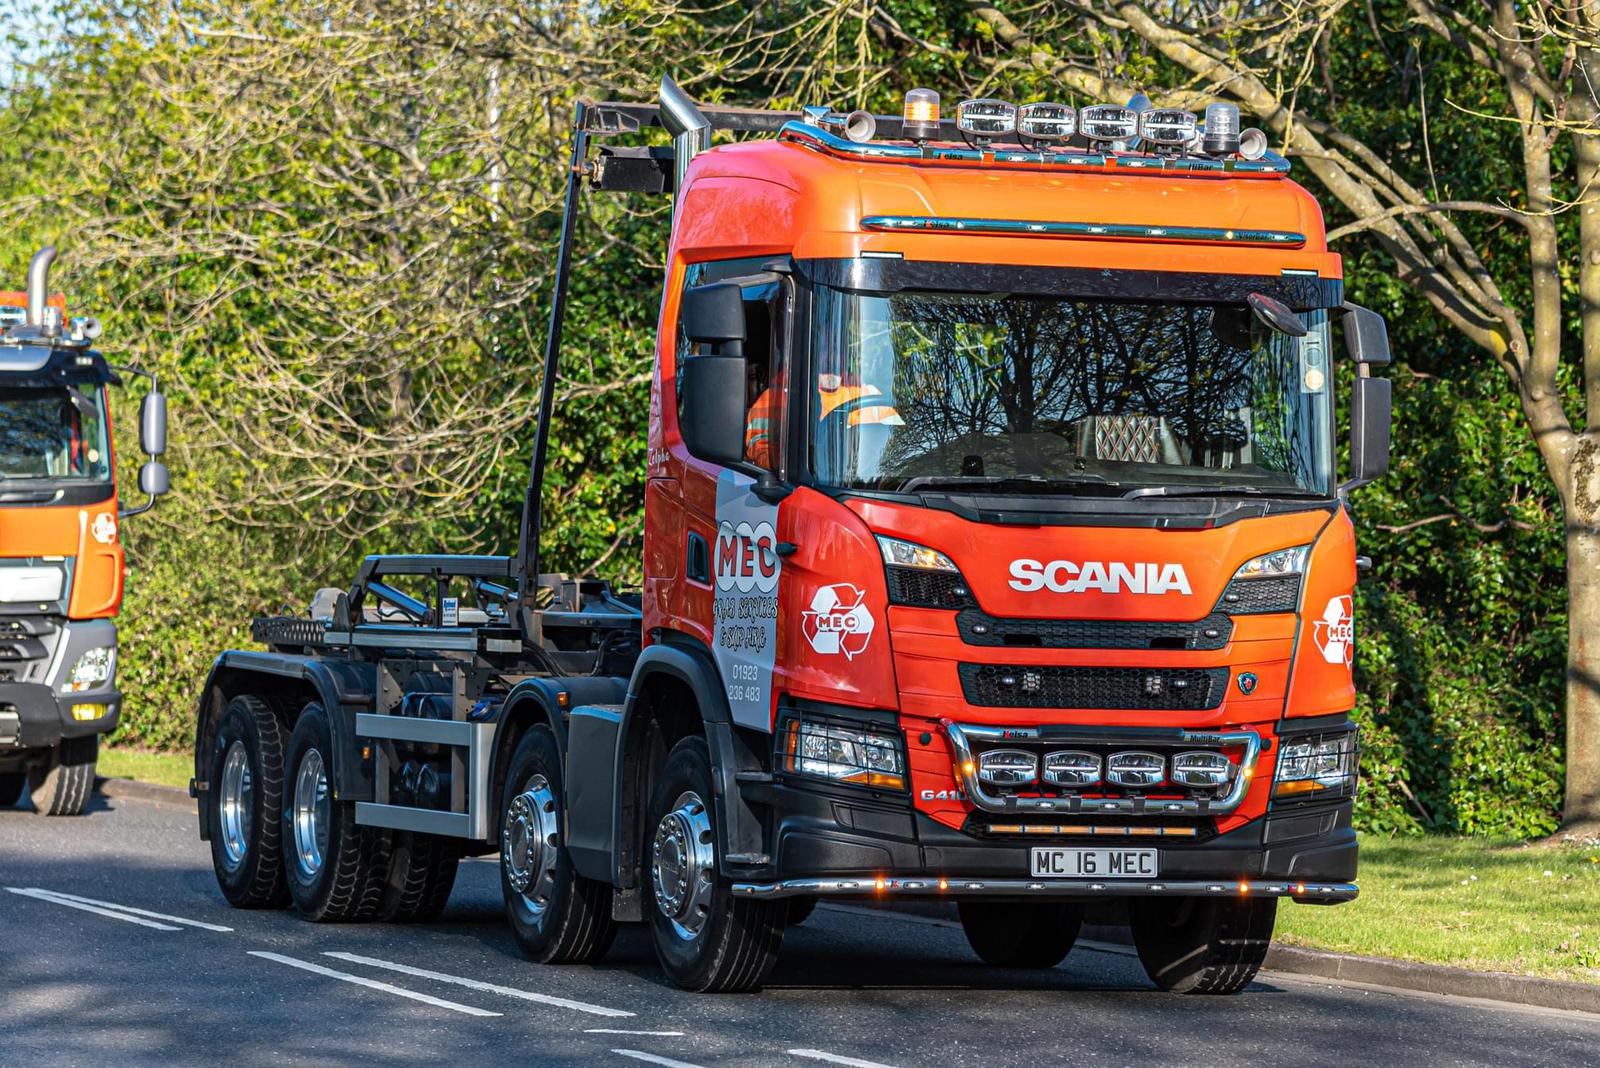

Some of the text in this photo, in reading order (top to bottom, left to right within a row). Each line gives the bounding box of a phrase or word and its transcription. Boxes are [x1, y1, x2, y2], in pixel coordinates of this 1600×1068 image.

[718, 535, 776, 578] MEC
[1008, 558, 1193, 595] SCANIA
[818, 616, 856, 628] MEC
[1330, 627, 1352, 638] MEC
[732, 664, 758, 680] 01923
[728, 685, 760, 702] 236 483
[1036, 851, 1152, 874] MC 16 MEC
